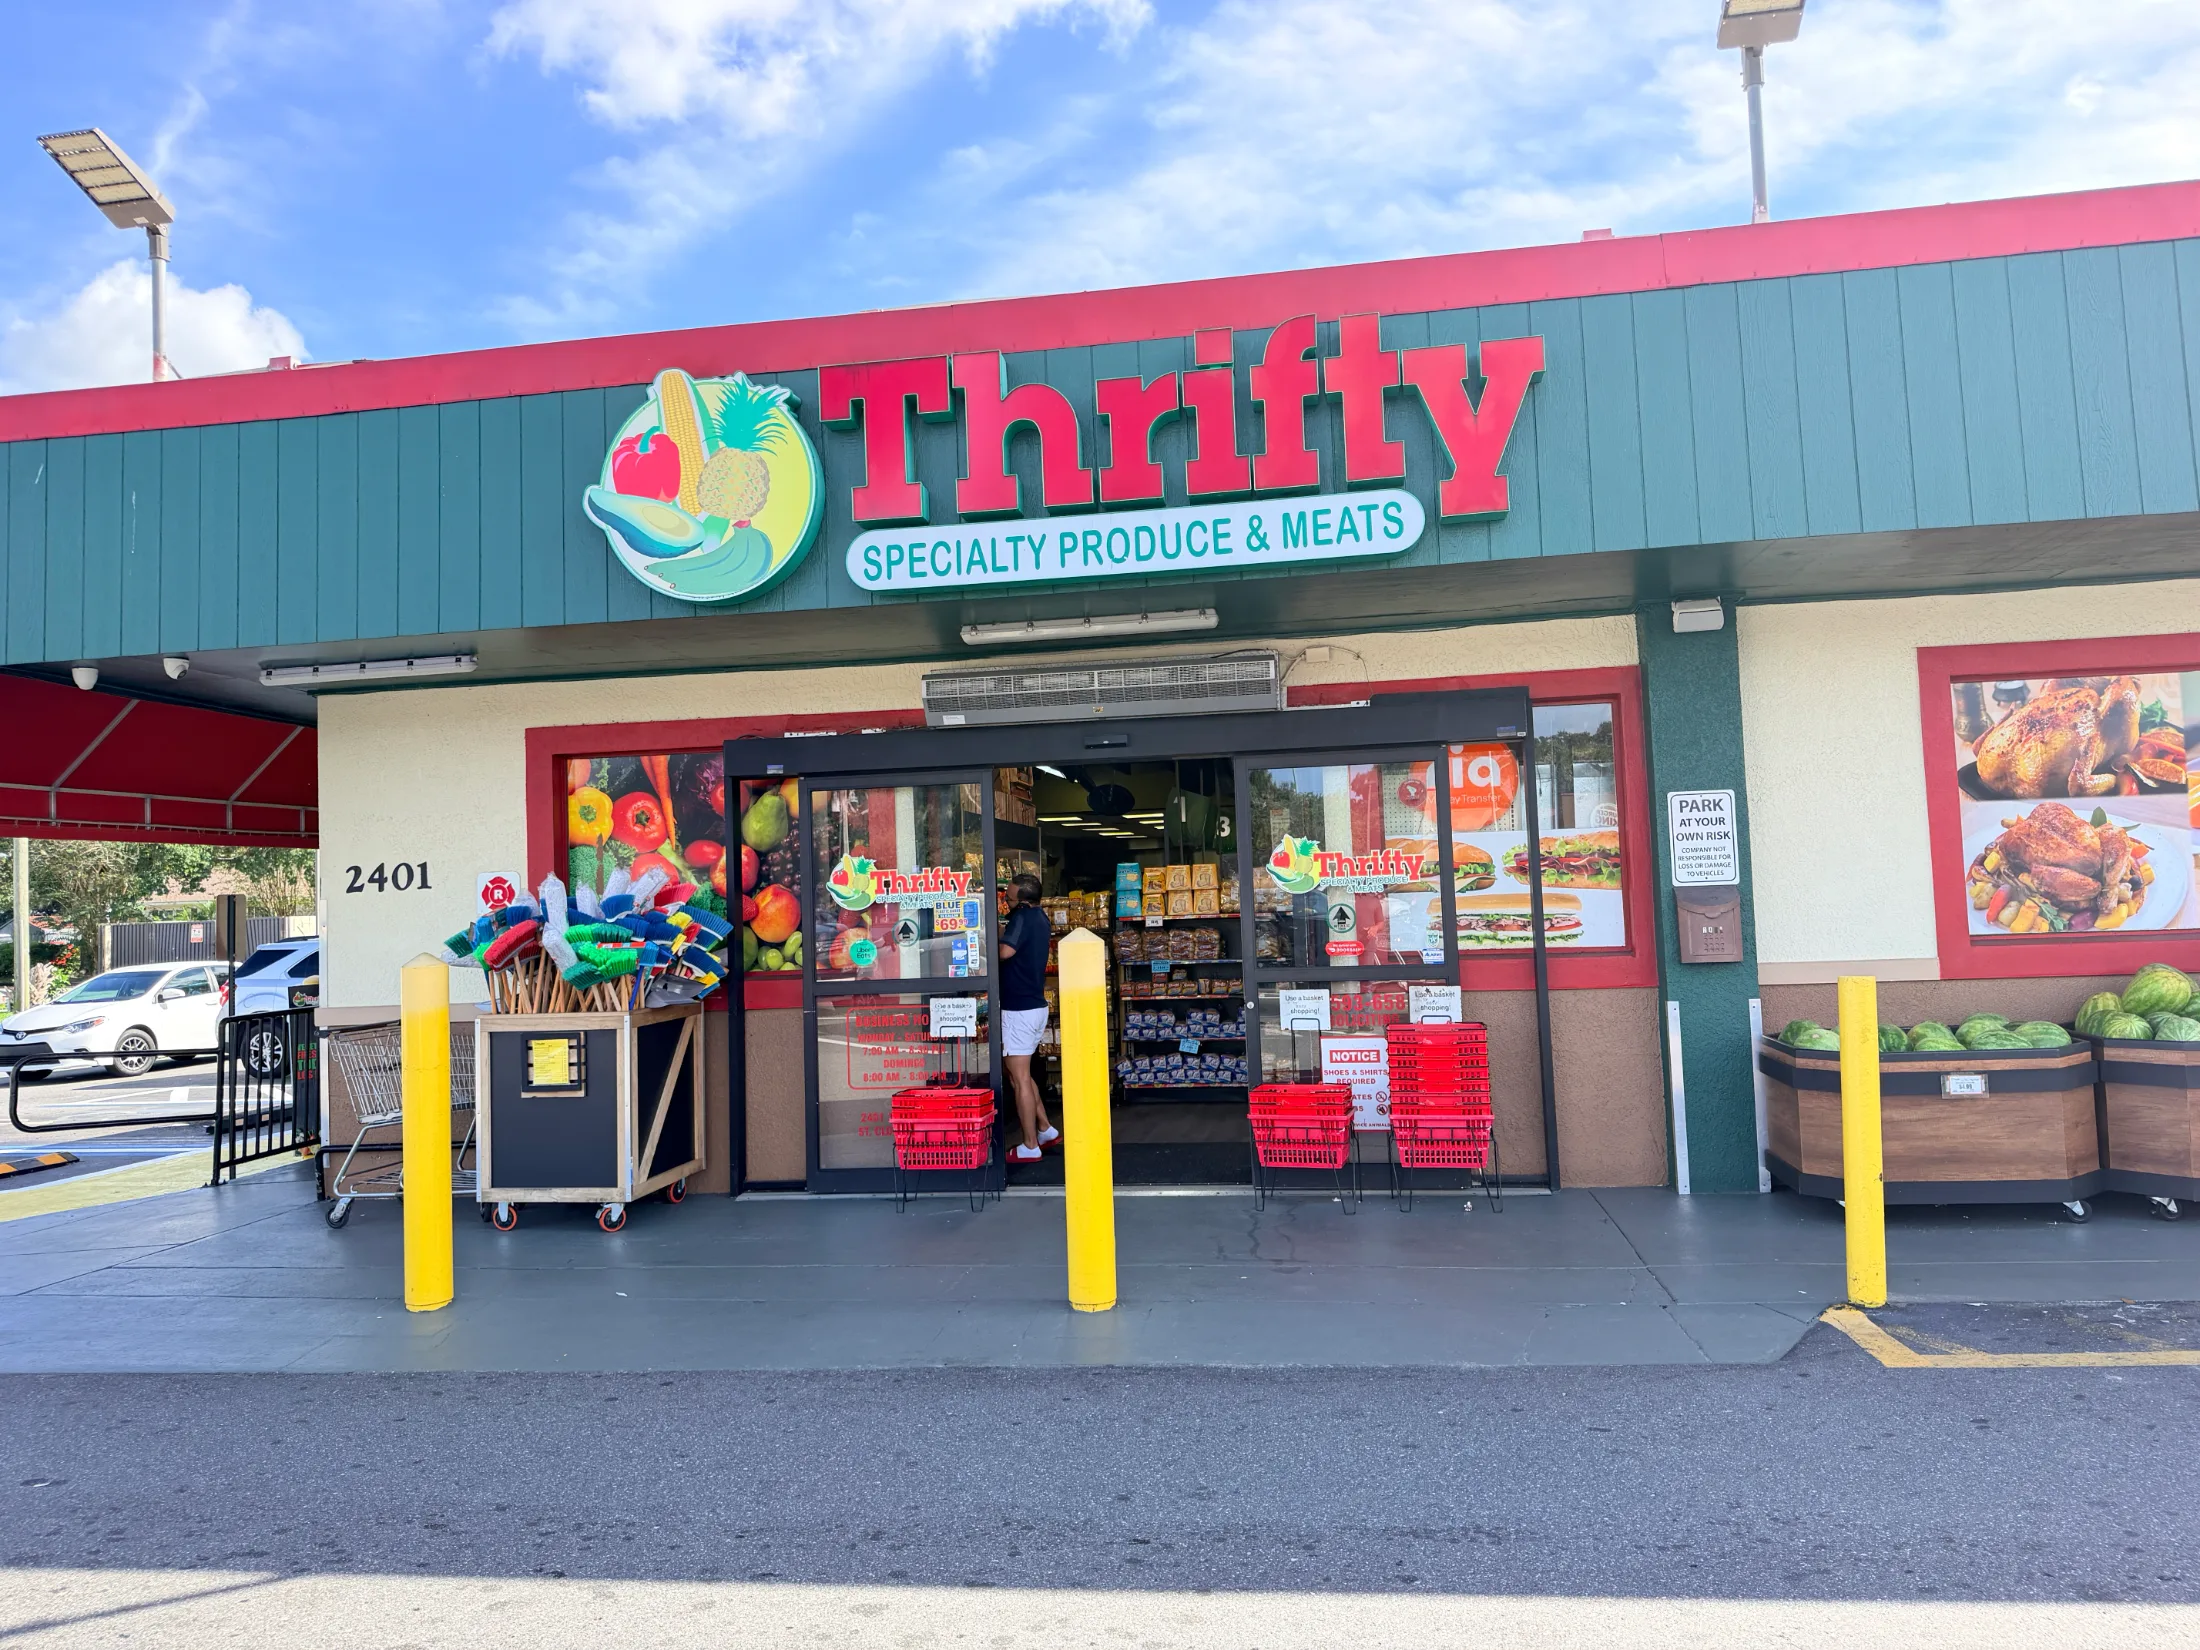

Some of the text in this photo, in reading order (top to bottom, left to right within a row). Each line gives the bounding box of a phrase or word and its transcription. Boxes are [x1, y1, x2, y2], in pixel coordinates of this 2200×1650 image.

[819, 312, 1545, 521] Thrifty
[863, 501, 1405, 582] SPECIALTY PRODUCE & MEATS
[1461, 794, 1502, 803] Transfer
[1679, 798, 1724, 813] PARK
[1679, 816, 1726, 828] AT YOUR
[1676, 830, 1731, 842] OWN RISK
[1681, 846, 1712, 854] COMPANY
[1677, 854, 1718, 862] RESPONSIBLE
[1313, 849, 1425, 881] Thrifty
[345, 861, 433, 894] 2401
[870, 867, 971, 897] Thrifty
[1320, 875, 1409, 887] SPECIALTY PRODUCE
[1355, 884, 1384, 892] MEATS
[493, 889, 503, 900] R
[876, 892, 956, 903] SPECIALTY PRODUCE
[908, 900, 934, 909] MEATS
[935, 901, 961, 910] BLUE
[1290, 1007, 1320, 1015] shopping!
[855, 1015, 910, 1027] BUSINESS
[940, 1015, 967, 1023] shopping!
[857, 1032, 896, 1043] MONDAY
[863, 1046, 882, 1056] 7:00
[885, 1046, 899, 1056] AM
[1332, 1051, 1378, 1062] NOTICE
[883, 1058, 926, 1068] DOMINGO
[886, 1071, 900, 1081] AM
[932, 1070, 947, 1081] PM
[1352, 1093, 1373, 1101] ATES
[860, 1111, 884, 1123] 2401
